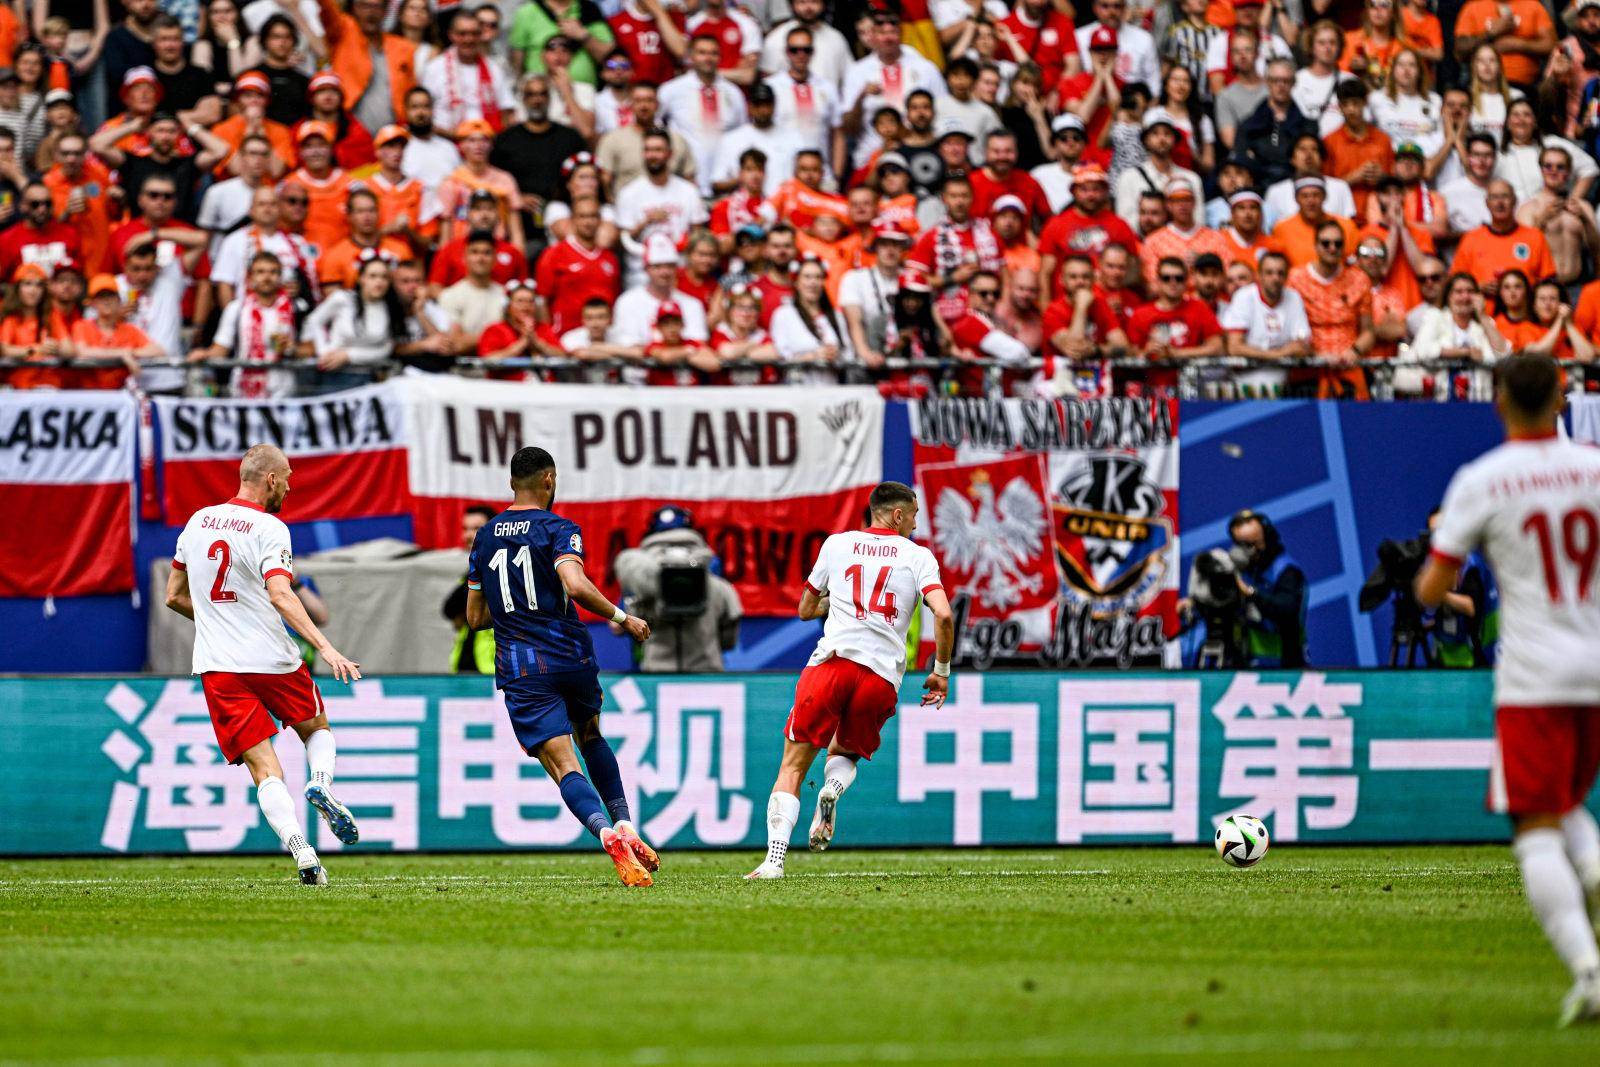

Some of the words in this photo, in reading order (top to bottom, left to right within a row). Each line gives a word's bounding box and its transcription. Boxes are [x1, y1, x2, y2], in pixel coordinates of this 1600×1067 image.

[0, 409, 119, 462] ĄSKA
[444, 404, 523, 467] LM
[572, 408, 798, 470] POLAND
[918, 398, 1015, 448] NOWA
[202, 516, 253, 534] SALAMON
[494, 521, 531, 537] GAKPO
[853, 542, 898, 558] KIWIOR
[207, 539, 238, 603] 2
[488, 545, 539, 613] 11
[1522, 508, 1600, 606] 19
[845, 564, 899, 627] 14
[101, 677, 754, 852] 海信电视
[897, 671, 1496, 846] 中国第一
